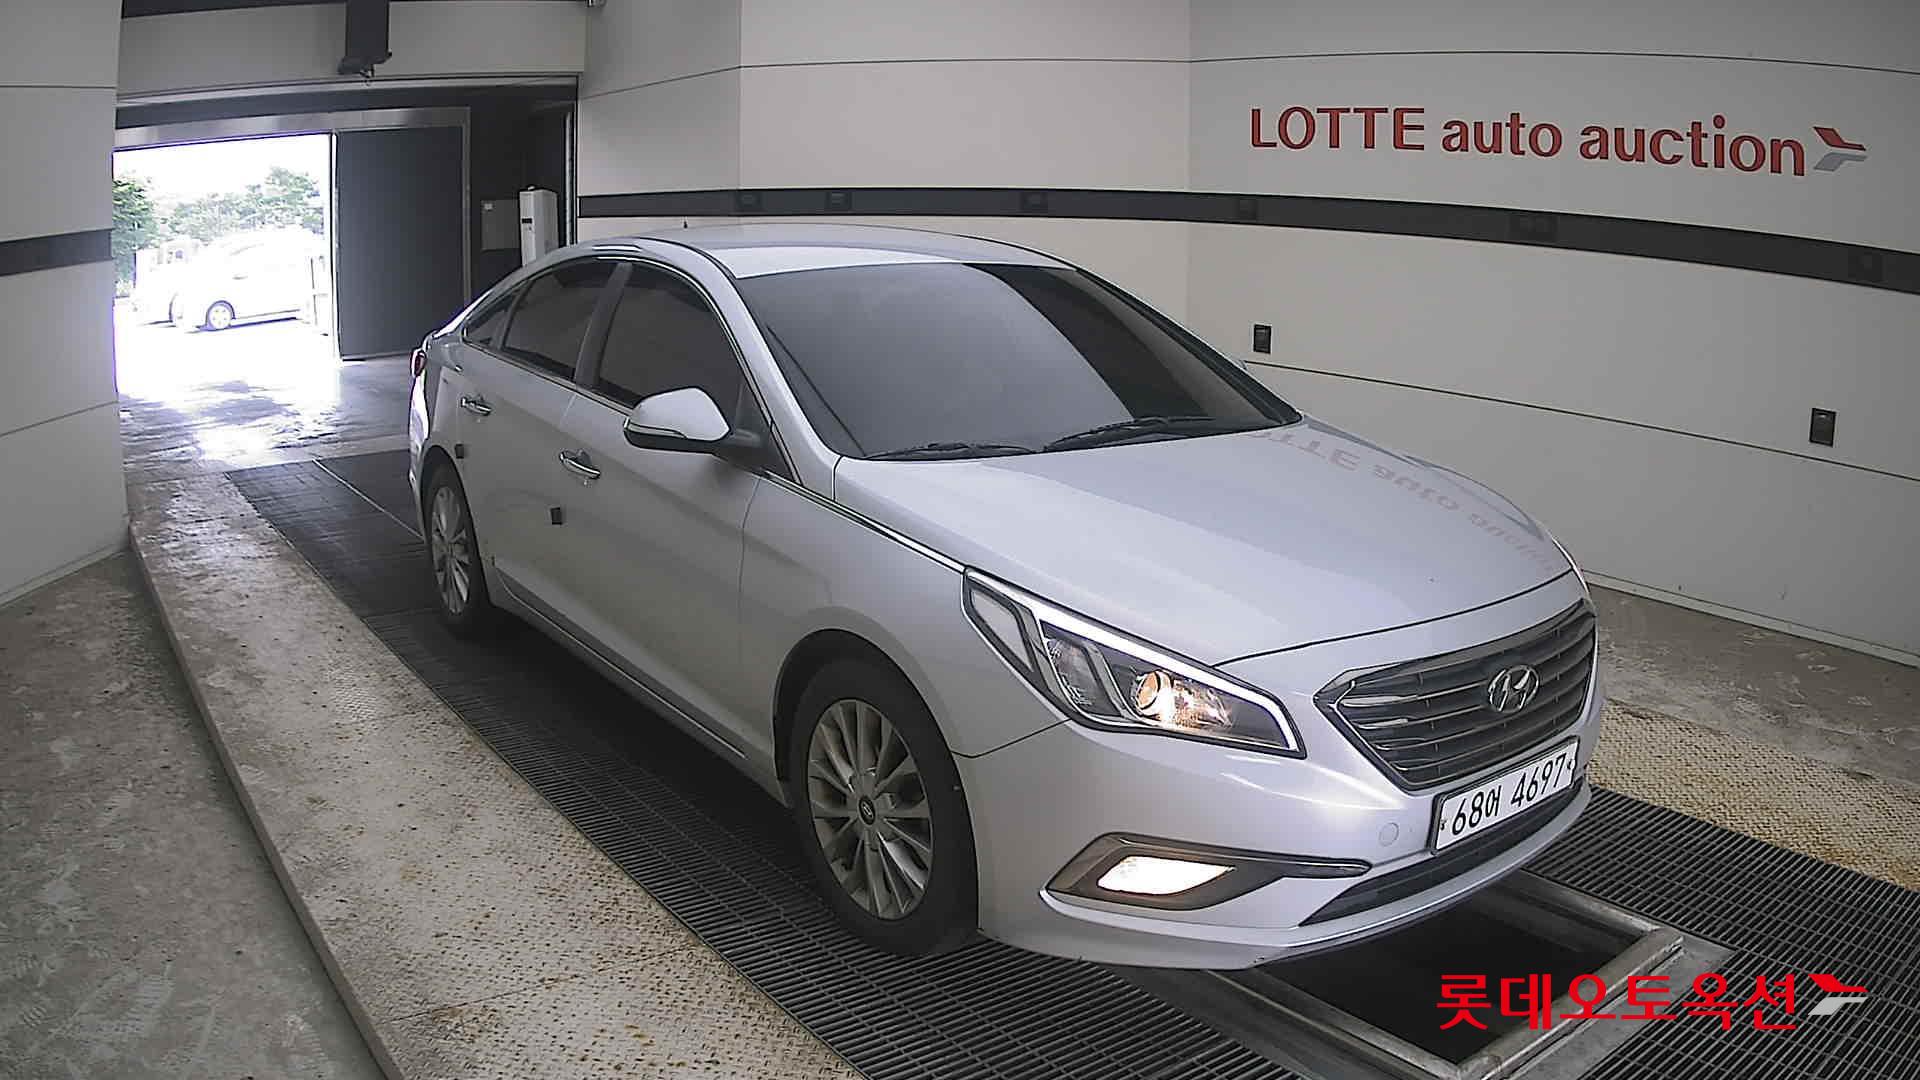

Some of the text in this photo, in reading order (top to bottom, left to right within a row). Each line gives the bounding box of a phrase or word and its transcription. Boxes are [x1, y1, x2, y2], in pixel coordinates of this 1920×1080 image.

[1251, 107, 1806, 176] LOTTE auto auction
[1452, 752, 1566, 836] 68어 4697
